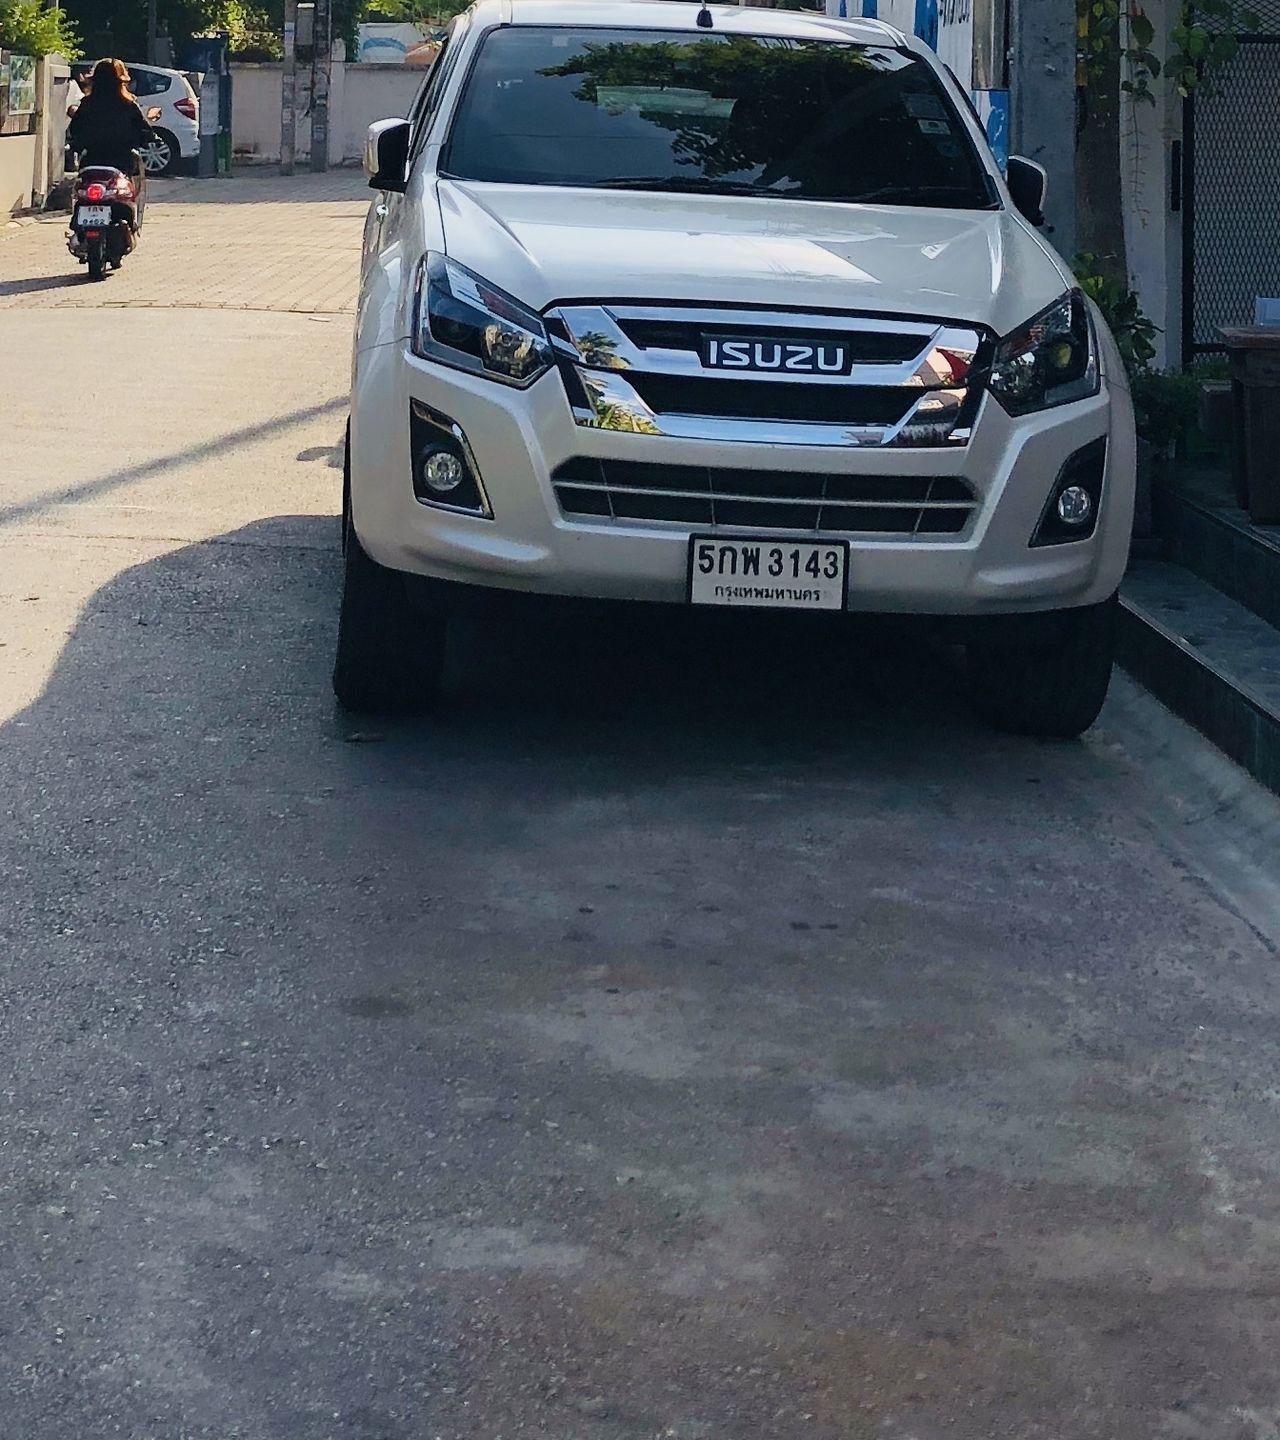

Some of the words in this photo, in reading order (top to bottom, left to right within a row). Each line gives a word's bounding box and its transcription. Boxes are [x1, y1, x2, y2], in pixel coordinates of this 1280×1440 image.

[709, 340, 844, 371] ISUZU
[698, 544, 761, 576] 5กพ
[768, 548, 839, 579] 3143
[714, 585, 821, 602] กรุงเทพมหานคร
